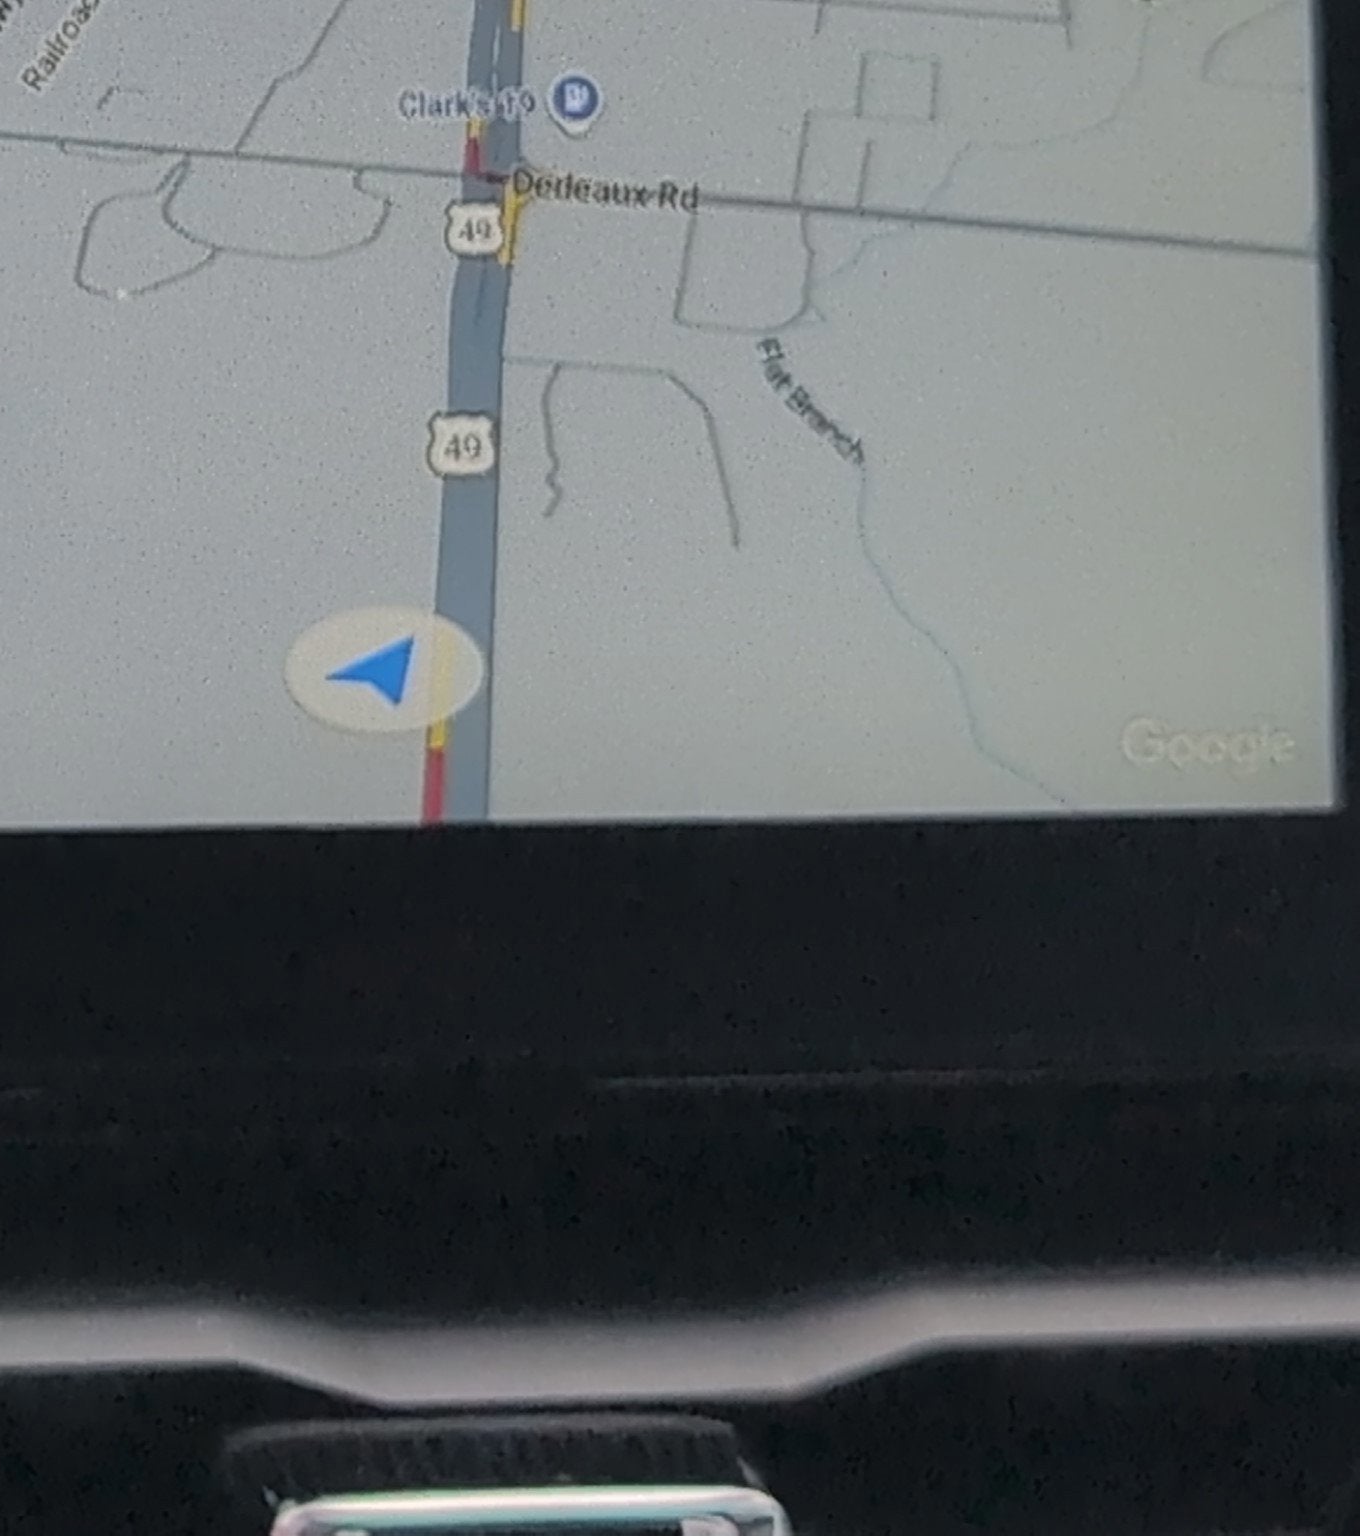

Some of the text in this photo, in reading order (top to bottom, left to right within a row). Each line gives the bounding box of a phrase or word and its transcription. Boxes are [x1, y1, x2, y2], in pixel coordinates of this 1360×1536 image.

[512, 168, 700, 213] Dedeaux Rd
[457, 217, 492, 242] 49
[756, 336, 867, 465] Flat Branch
[443, 434, 482, 464] 49
[1121, 714, 1298, 784] Google
